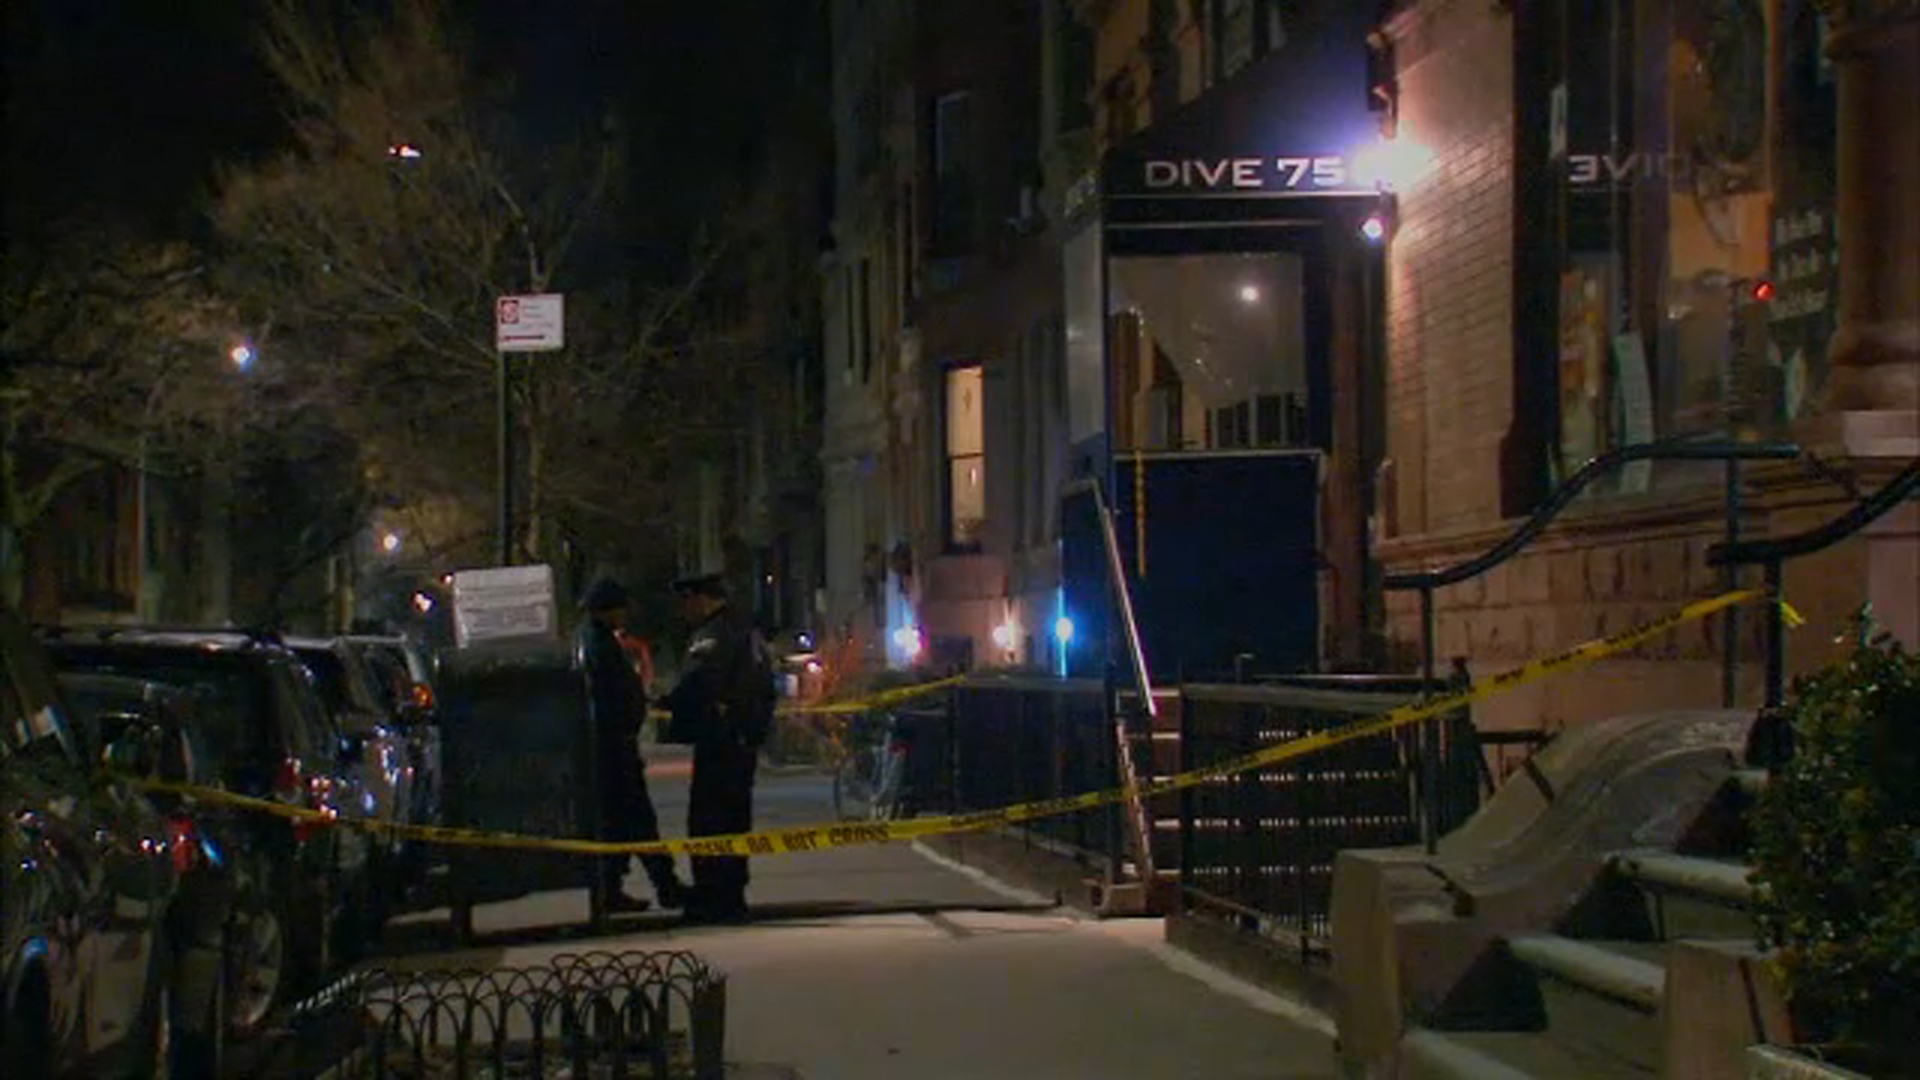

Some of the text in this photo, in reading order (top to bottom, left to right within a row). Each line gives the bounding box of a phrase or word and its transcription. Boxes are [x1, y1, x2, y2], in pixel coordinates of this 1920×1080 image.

[1145, 156, 1345, 187] DIVE 75
[829, 823, 889, 846] CROSS
